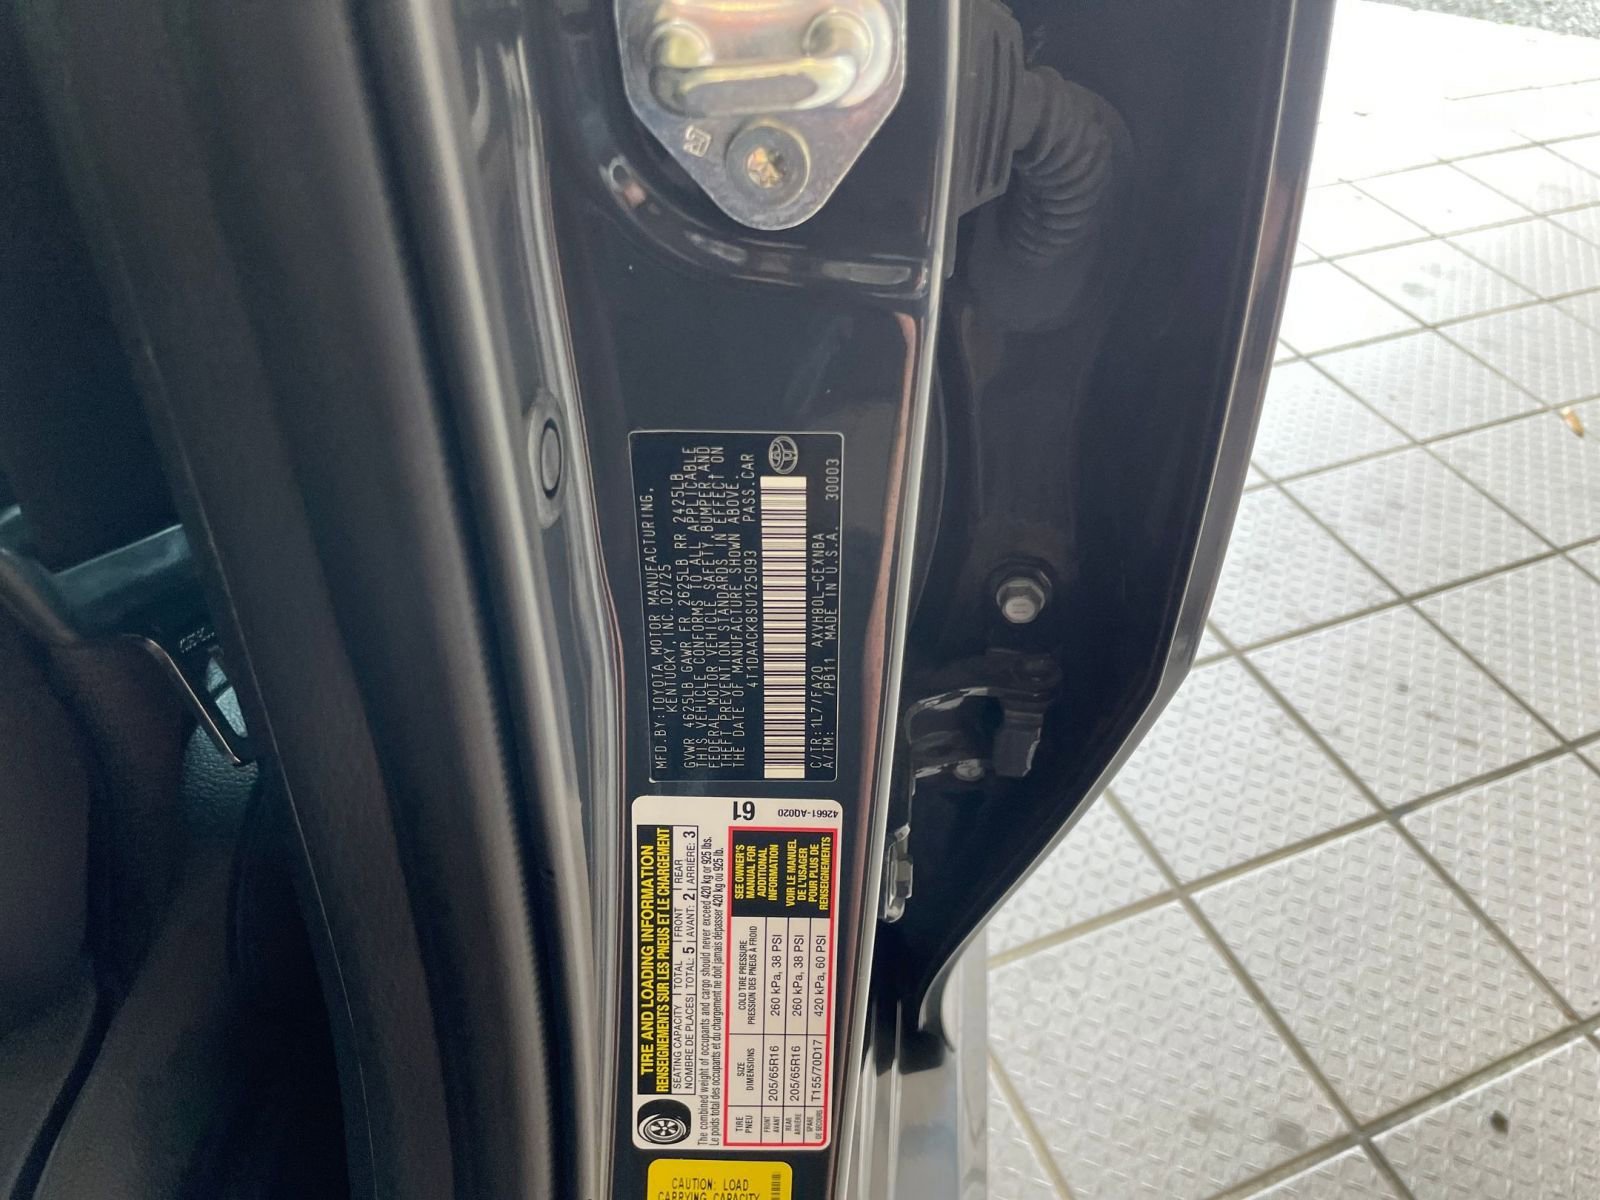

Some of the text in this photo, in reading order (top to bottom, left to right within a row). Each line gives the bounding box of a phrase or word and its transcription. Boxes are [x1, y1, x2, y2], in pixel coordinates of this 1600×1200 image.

[825, 458, 840, 501] 30003
[825, 526, 838, 574] U.S.A.
[811, 533, 825, 647] AXVH80L-CEXNBA
[825, 583, 837, 596] IN
[682, 447, 707, 767] THIS VEHICLE CONFORMS TO ALL APPLICABLE
[710, 447, 732, 767] THEFT PREVENTION STANDARDS IN EFFECT ON
[744, 550, 758, 688] 4T1DAACK8SU125093
[670, 473, 695, 768] GVWR 4625LB GAWR FR 2625LB RR 2425LB
[704, 601, 718, 656] VEHICLE
[726, 475, 744, 767] THE DATE OF MANUFACTURE SHOWN ABOVE.
[824, 609, 837, 640] MADE
[649, 614, 662, 655] MOTOR
[706, 666, 719, 705] MOTOR
[708, 714, 720, 768] FEDERAL
[823, 731, 834, 768] A/TM:
[733, 801, 755, 820] 61
[778, 809, 838, 818] 42661-AQ020
[702, 837, 712, 849] lbs.
[714, 848, 724, 856] lb.
[674, 859, 683, 883] REAR
[701, 852, 712, 864] 925
[713, 859, 723, 871] 925
[701, 876, 713, 884] kg
[735, 845, 744, 899] SEE OWNER'S
[746, 846, 756, 898] MANUAL FOR
[757, 848, 767, 897] ADDITIONAL
[768, 844, 778, 900] INFORMATION
[786, 839, 797, 906] VOIR LE MANUEL
[797, 848, 807, 900] DE L'USAGER
[808, 844, 819, 902] POUR PLUS DE
[819, 837, 830, 910] RENSEIGNEMENTS
[701, 886, 711, 899] 420
[713, 884, 725, 892] kg
[713, 894, 723, 907] 420
[674, 907, 683, 937] FRONT
[686, 906, 695, 937] AVANT:
[701, 901, 711, 926] exceed
[712, 909, 724, 940] dépasser
[702, 929, 710, 949] never
[749, 926, 757, 946] FROID
[772, 935, 782, 951] PSI
[794, 935, 804, 952] PSI
[816, 936, 826, 952] PSI
[641, 845, 654, 1075] TIRE AND LOADING INFORMATION
[656, 828, 670, 1092] RENSEIGNEMENTS SUR LES PNEUS ET LE CHARGEMENT
[700, 953, 710, 976] should
[712, 942, 724, 964] jamais
[739, 940, 747, 974] PRESSURE
[772, 956, 782, 968] 38
[793, 956, 803, 968] 38
[815, 957, 825, 969] 60
[674, 961, 682, 989] TOTAL
[686, 958, 694, 988] TOTAL:
[712, 966, 722, 978] doit
[771, 972, 782, 994] kPa,
[792, 972, 804, 994] kPa,
[814, 972, 826, 994] kPa,
[702, 980, 712, 1000] cargo
[738, 993, 746, 1010] COLD
[686, 997, 694, 1031] PLACES
[700, 1003, 710, 1015] and
[711, 991, 723, 1030] chargement
[748, 992, 756, 1024] PRESSION
[770, 998, 780, 1016] 260
[792, 998, 802, 1016] 260
[814, 998, 824, 1016] 420
[674, 1005, 682, 1048] CAPACITY
[700, 1019, 712, 1055] occupants
[710, 1033, 720, 1041] du
[685, 1034, 693, 1046] DE
[685, 1049, 693, 1089] NOMBRE
[699, 1068, 711, 1092] weight
[711, 1052, 722, 1086] occupants
[737, 1062, 745, 1076] SIZE
[746, 1048, 754, 1090] DIMENSIONS
[768, 1046, 779, 1101] 205/65R16
[790, 1046, 800, 1101] 205/65R16
[811, 1040, 822, 1101] T155/70D17
[710, 1088, 720, 1099] des
[699, 1095, 708, 1129] combined
[710, 1102, 720, 1116] total
[698, 1133, 708, 1145] The
[710, 1118, 721, 1136] poids
[723, 1178, 749, 1191] LOAD
